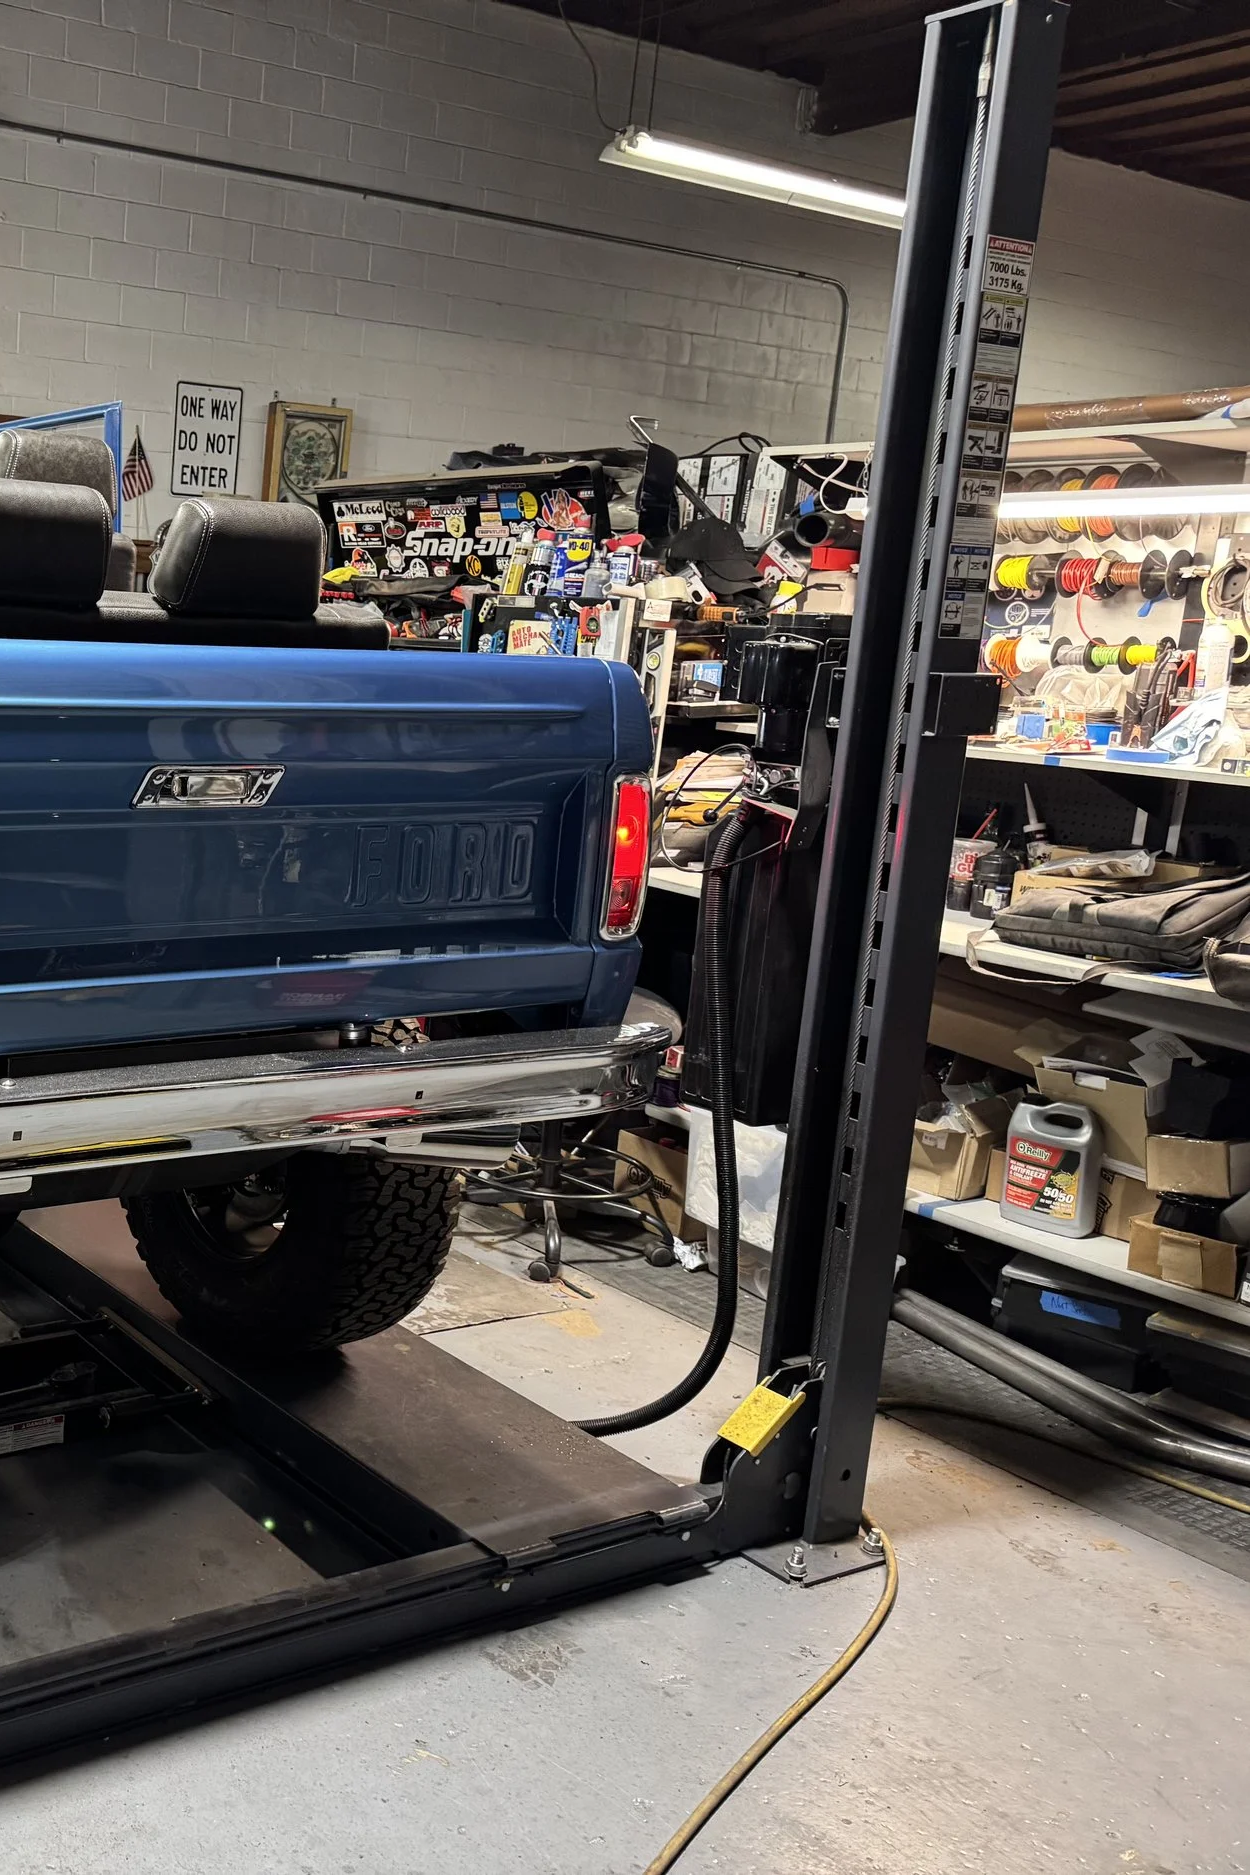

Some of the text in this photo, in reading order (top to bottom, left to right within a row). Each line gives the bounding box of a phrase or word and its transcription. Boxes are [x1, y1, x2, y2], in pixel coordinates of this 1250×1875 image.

[990, 261, 1026, 277] 7000 Lbs.
[989, 276, 1023, 292] 3175 Kg.
[181, 395, 237, 421] ONE WAY
[178, 429, 235, 455] DO NOT
[180, 464, 227, 488] ENTER
[344, 502, 383, 515] McLeod
[403, 530, 517, 563] Snap-on
[512, 626, 531, 636] AUTO
[513, 639, 531, 650] MATE
[348, 822, 536, 908] FORD
[1017, 1141, 1050, 1161] O'Reilly
[1010, 1164, 1047, 1180] ANTIFREEZE
[1043, 1187, 1074, 1203] 50/50
